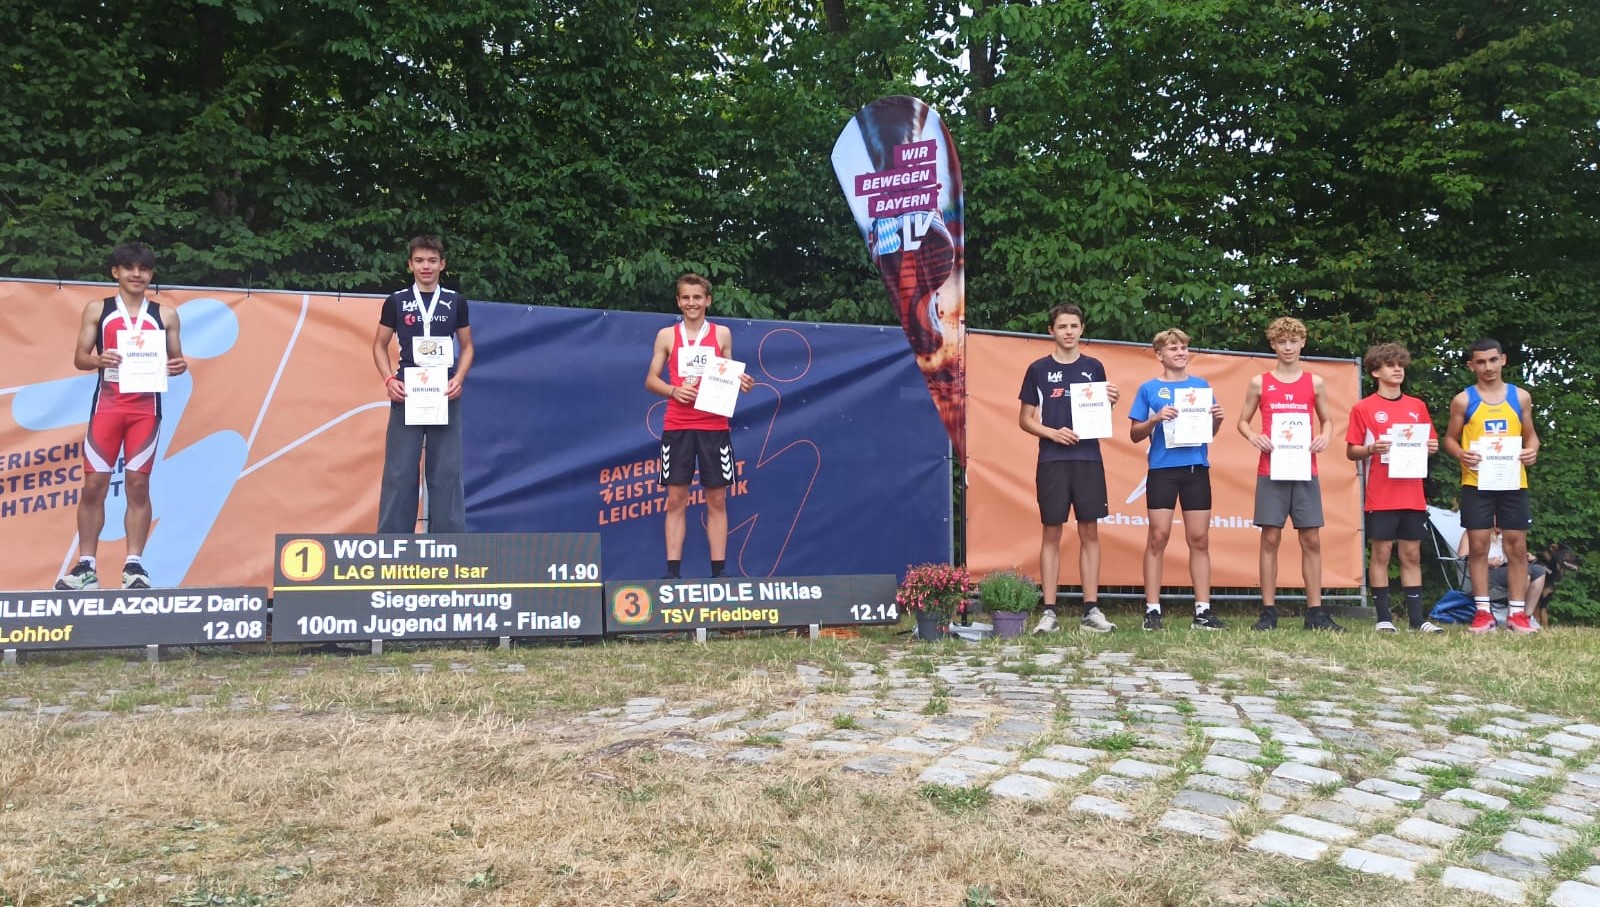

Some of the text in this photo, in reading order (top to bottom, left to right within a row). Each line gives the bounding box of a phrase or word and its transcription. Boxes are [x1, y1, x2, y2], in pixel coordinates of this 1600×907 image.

[902, 146, 928, 161] WIR
[862, 169, 930, 191] BEWEGEN
[876, 193, 930, 212] BAYERN
[877, 212, 936, 255] BLV
[295, 546, 309, 573] 1
[333, 539, 457, 559] WOLF Tim
[333, 563, 599, 580] LAG Mittlere Isar 11.90
[370, 590, 512, 612] Siegerehrung
[659, 581, 822, 603] STEIDLE Niklas
[68, 595, 202, 616] VELAZQUEZ
[207, 594, 262, 612] Dario
[624, 592, 640, 617] 3
[660, 603, 898, 623] TSV Friedberg 12.14
[0, 621, 262, 643] Lohhof 12.08
[297, 615, 357, 635] 100m
[363, 613, 446, 637] Jugend
[453, 613, 498, 632] M14
[518, 611, 581, 630] Finale
